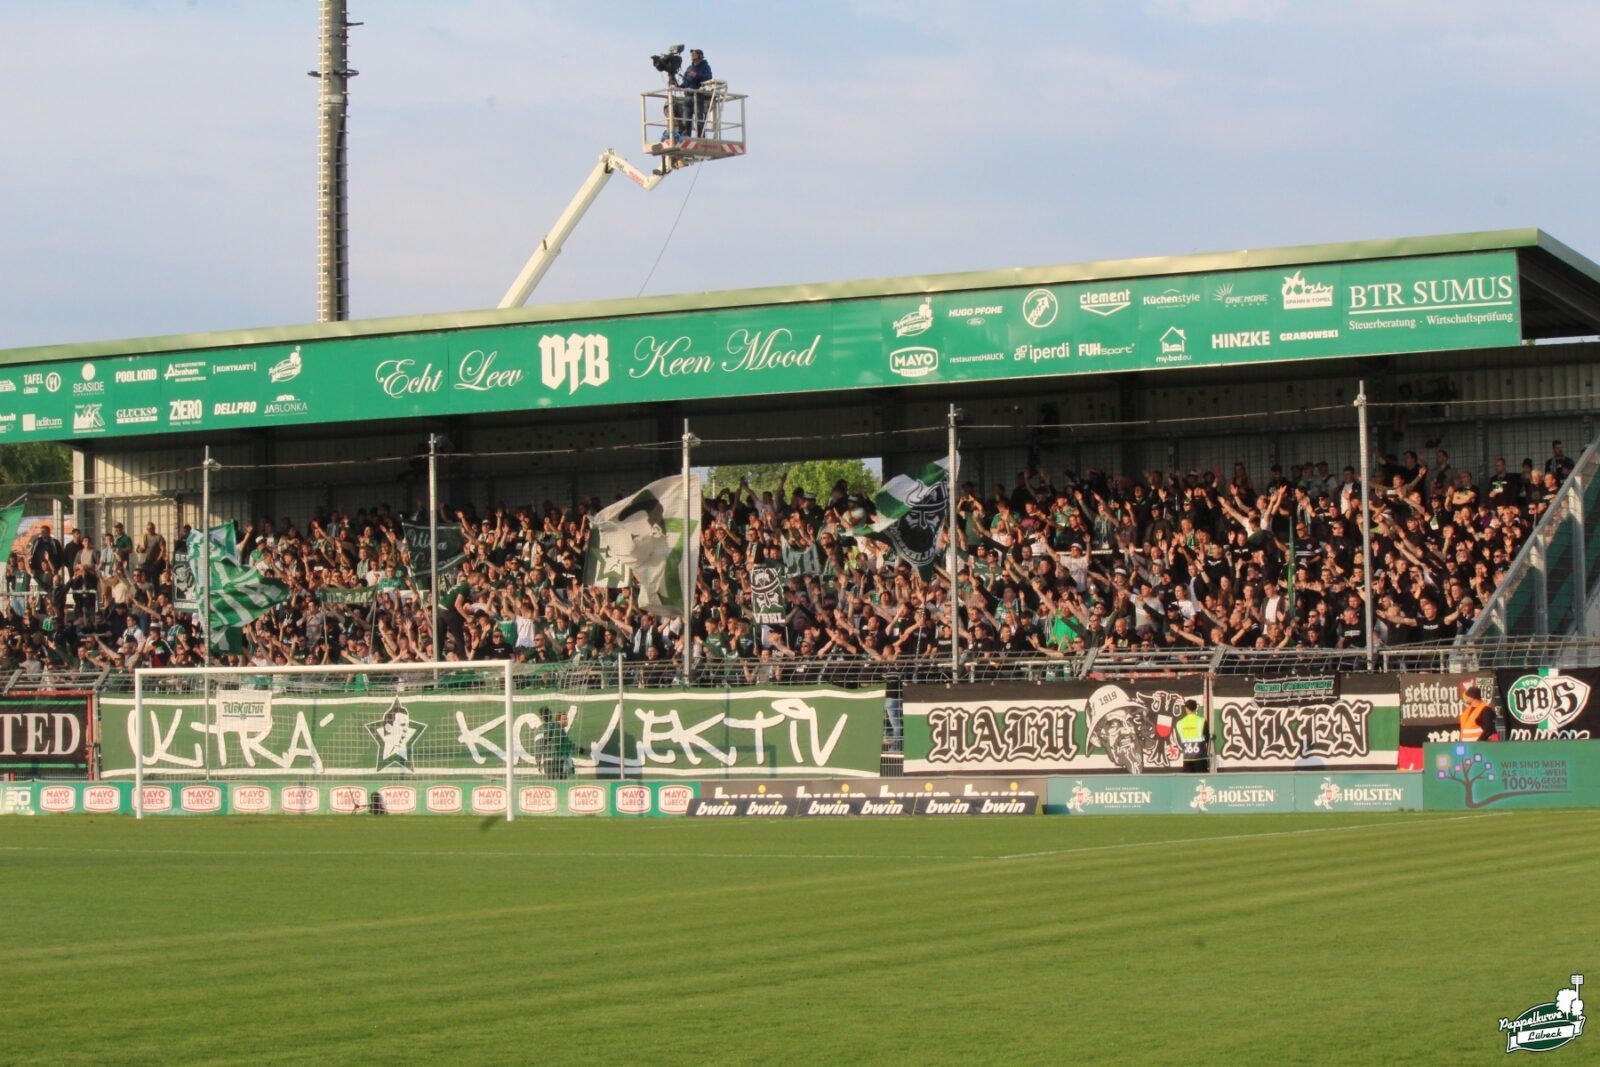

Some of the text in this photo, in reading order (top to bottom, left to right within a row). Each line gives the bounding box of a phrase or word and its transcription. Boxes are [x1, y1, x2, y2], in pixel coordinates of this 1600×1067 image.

[1080, 289, 1131, 305] clement
[1349, 275, 1513, 309] BTR SUMUS
[1143, 293, 1200, 305] Küchenstyle
[949, 306, 1003, 317] HUGO PFOHE
[1349, 312, 1514, 330] Steuerberatung Wirtschaftsprüfung
[1212, 330, 1271, 349] HINZKE
[1280, 329, 1339, 341] GRABOWSKI
[1029, 342, 1070, 363] iperdi
[375, 328, 821, 399] Echt Leev VfB Keen Mood
[894, 353, 934, 368] MAYO
[24, 373, 44, 384] TAFEL
[73, 381, 104, 393] SEASIDE
[214, 401, 257, 415] DELLPRO
[264, 402, 308, 414] JABLONKA
[753, 612, 786, 624] VBHL
[1404, 682, 1459, 703] sektion
[1514, 687, 1549, 713] VfB
[1502, 760, 1566, 769] WIR SIND MEHR
[1502, 769, 1517, 777] ALS
[1502, 777, 1541, 791] 100%
[47, 790, 70, 798] MAYO
[90, 790, 114, 798] MAYO
[188, 790, 214, 798] MAYO
[240, 790, 264, 798] MAYO
[288, 790, 313, 798] MAYO
[336, 791, 361, 799] MAYO
[385, 791, 410, 799] MAYO
[432, 791, 455, 799] MAYO
[479, 791, 502, 799] MAYO
[525, 791, 550, 799] MAYO
[575, 791, 598, 799] MAYO
[622, 791, 645, 799] MAYO
[664, 791, 687, 799] MAYO
[1094, 792, 1151, 804] HOLSTEN
[1218, 789, 1275, 803] HOLSTEN
[1344, 788, 1402, 801] HOLSTEN
[696, 801, 737, 816] bwin
[746, 801, 788, 816] bwin
[808, 800, 850, 815] bwin
[860, 800, 904, 815] bwin
[925, 799, 970, 814] bwin
[981, 798, 1026, 814] bwin
